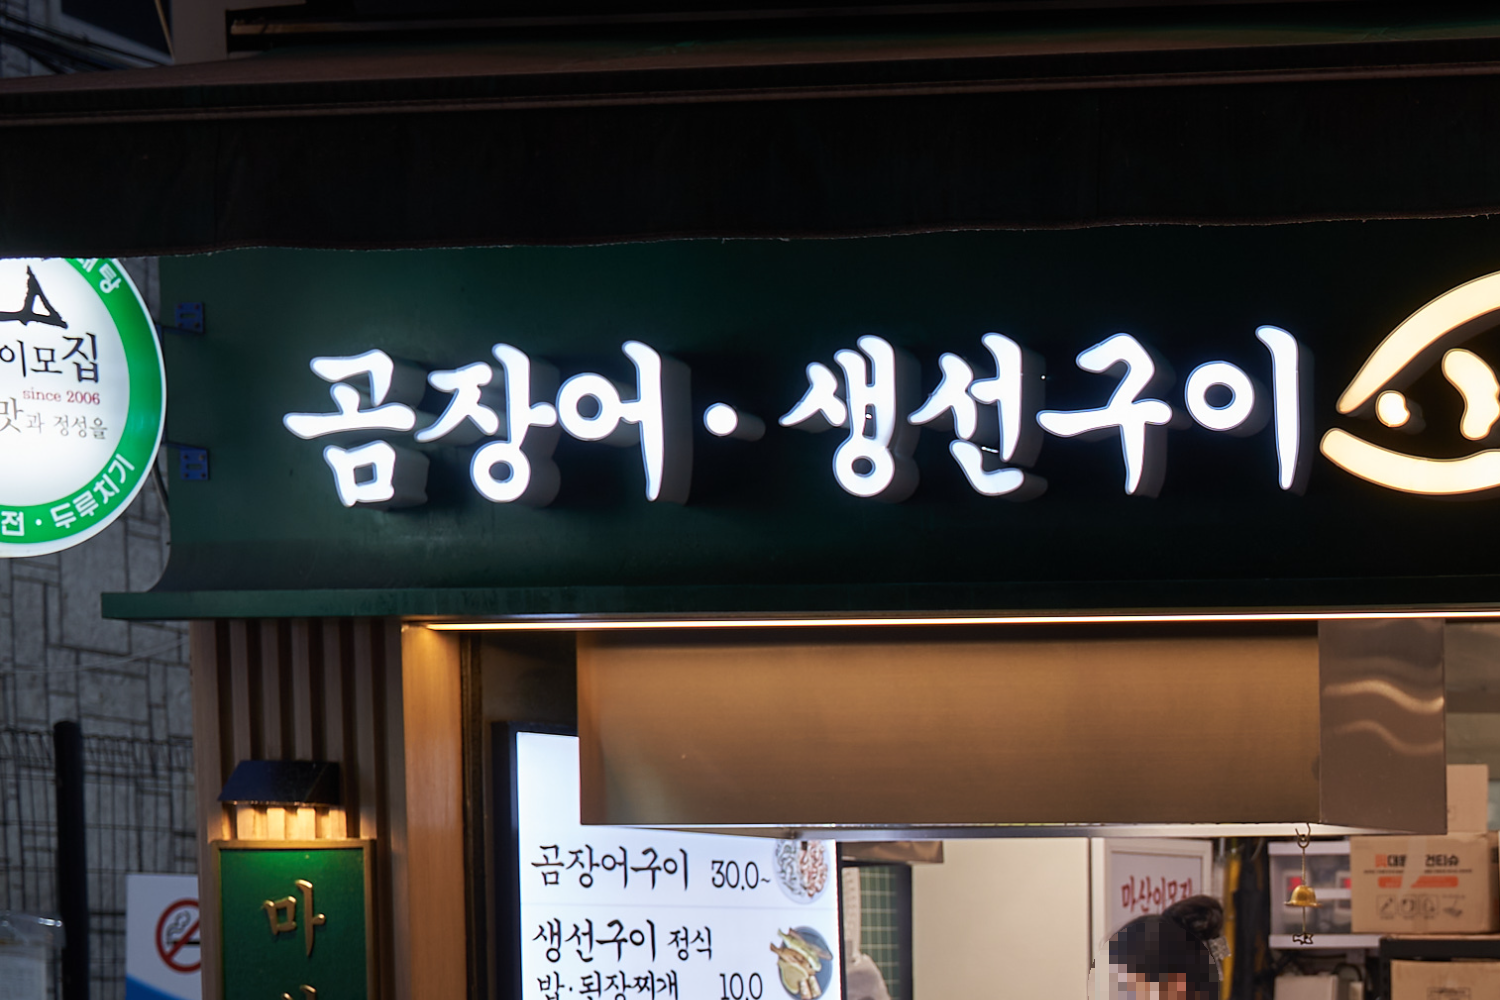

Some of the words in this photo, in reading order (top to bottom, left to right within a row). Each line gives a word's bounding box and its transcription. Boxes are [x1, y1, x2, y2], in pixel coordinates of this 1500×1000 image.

[22, 386, 62, 403] since
[66, 390, 101, 406] 2006
[283, 340, 664, 507] 곰장어
[779, 324, 1300, 497] 생선구이
[53, 413, 108, 440] 정성을
[50, 453, 136, 529] 두루치기
[531, 844, 689, 891] 곰장어구이
[532, 918, 656, 963] 생선구이
[667, 925, 713, 961] 정식
